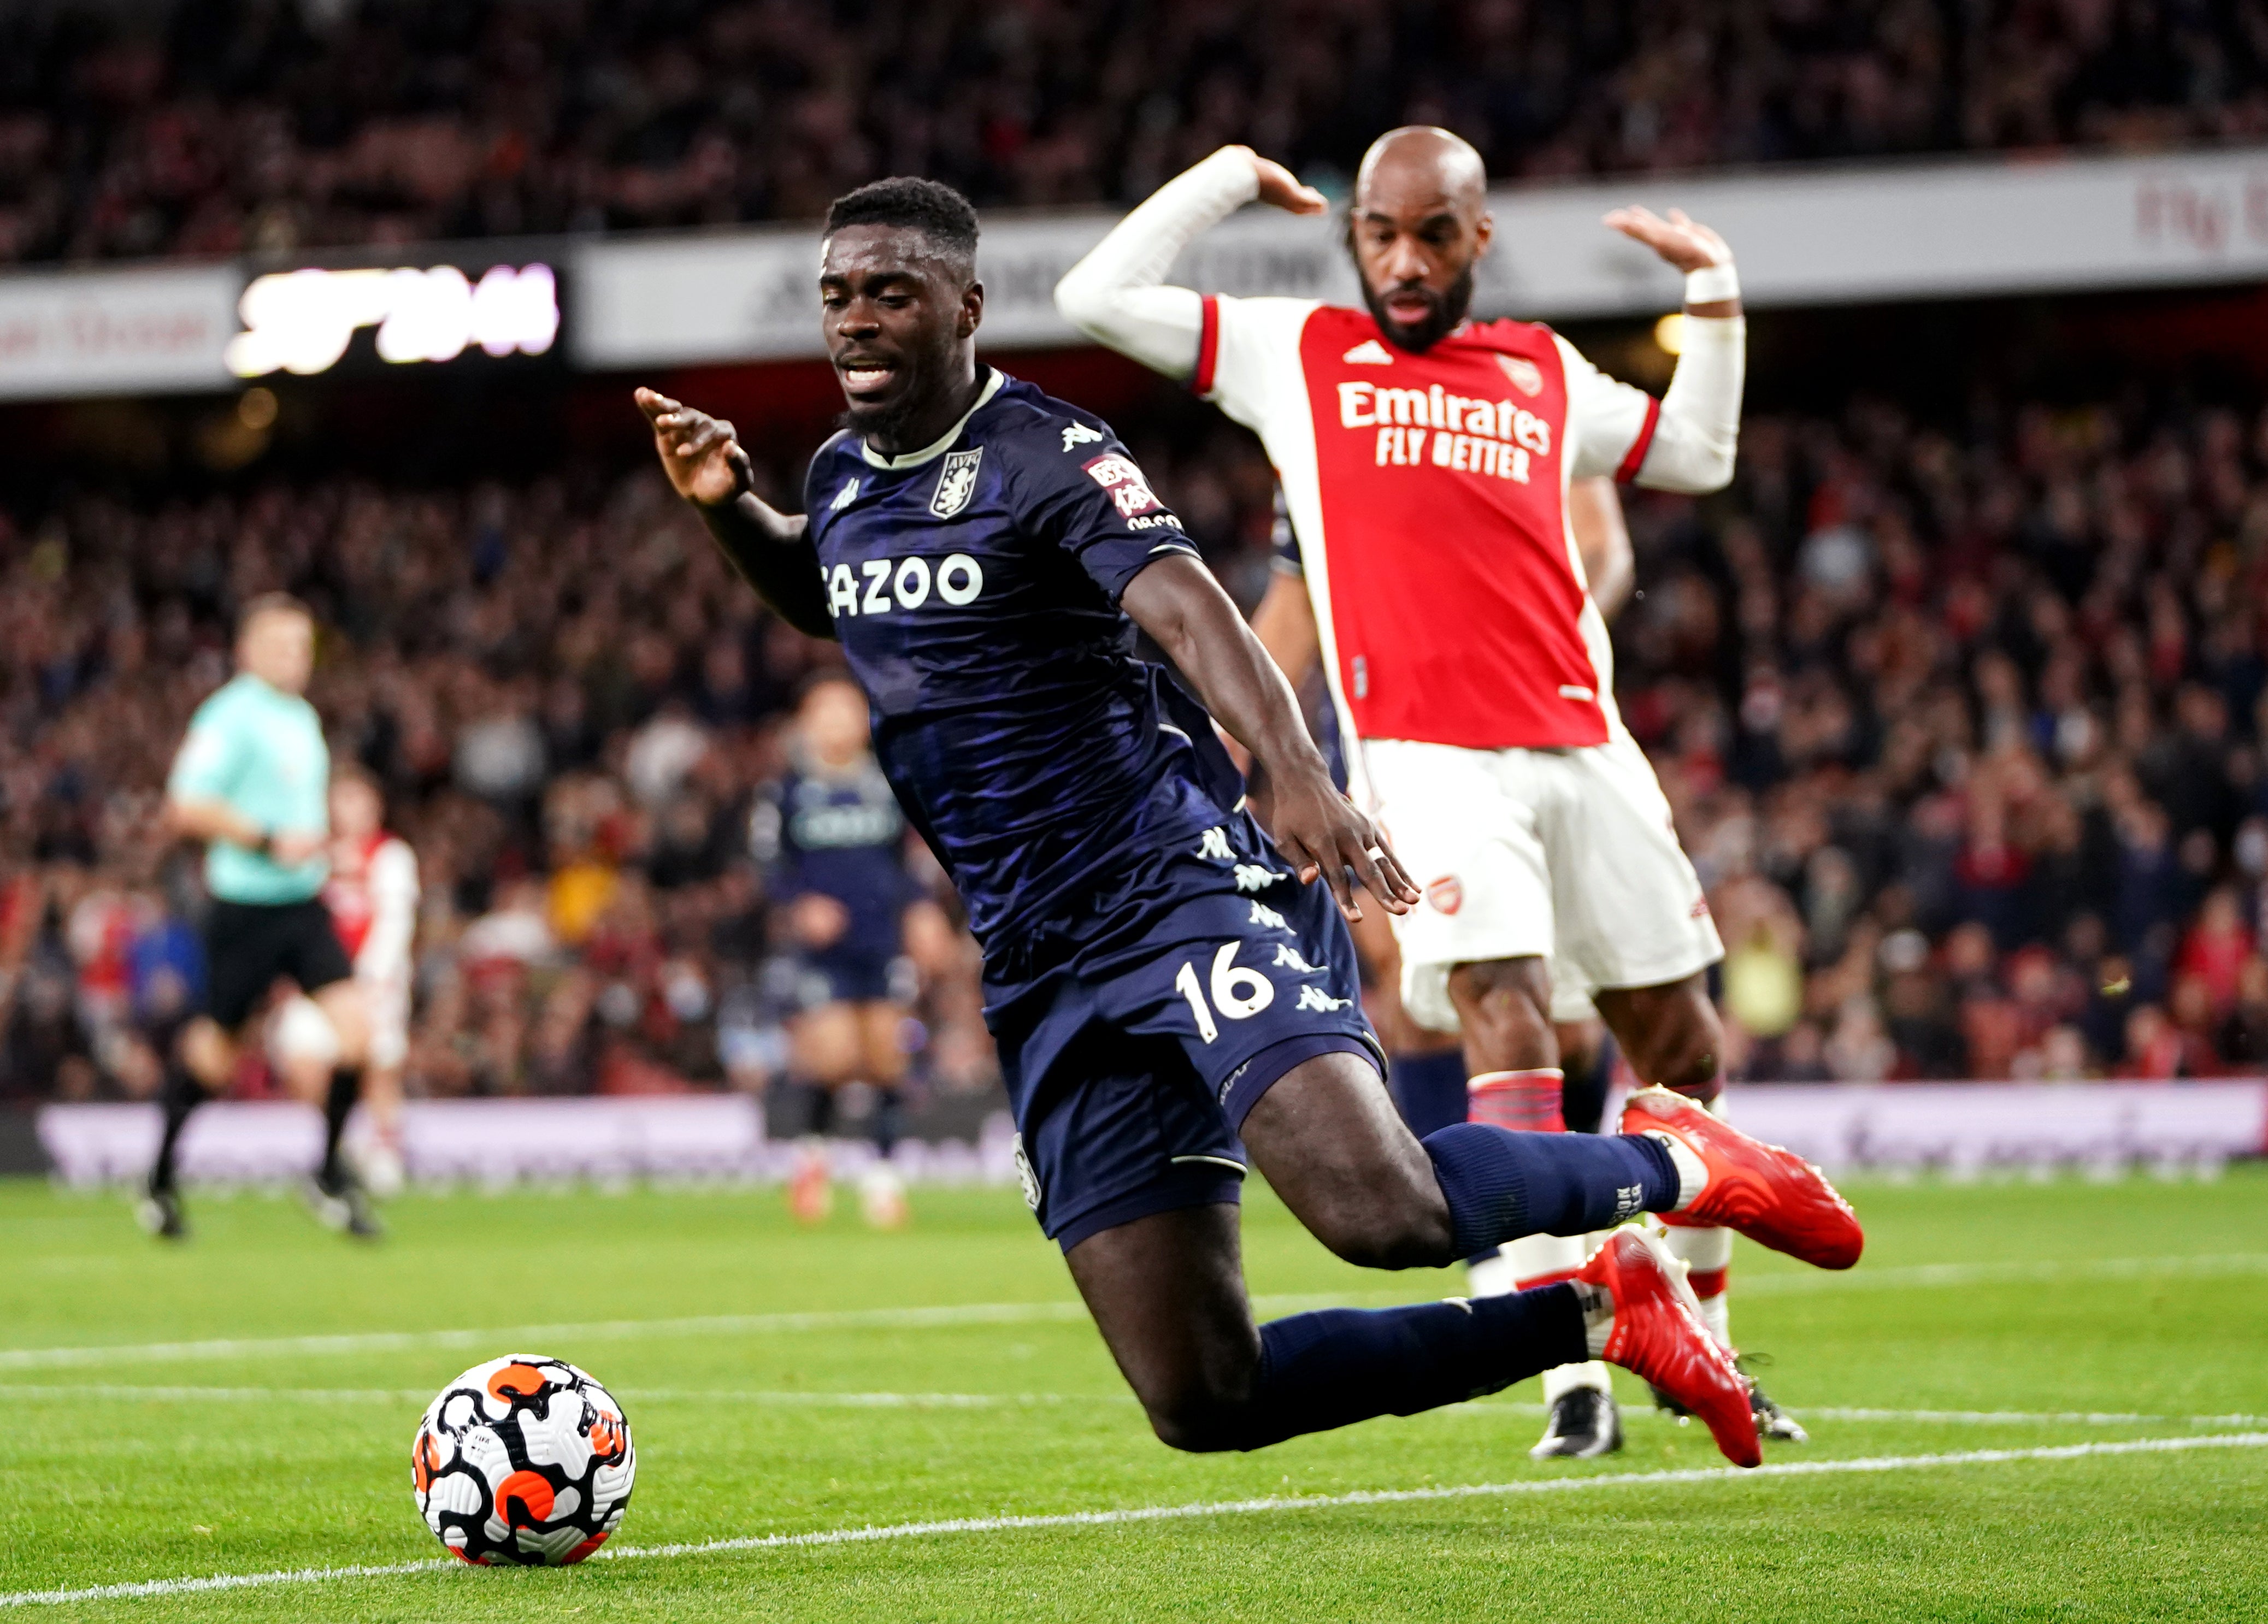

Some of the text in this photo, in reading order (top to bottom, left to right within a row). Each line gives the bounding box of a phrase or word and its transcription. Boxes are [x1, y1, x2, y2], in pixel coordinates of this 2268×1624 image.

[1337, 381, 1551, 457] Emirates
[1375, 427, 1530, 485] FLY BETTER
[1175, 940, 1275, 1044] 16
